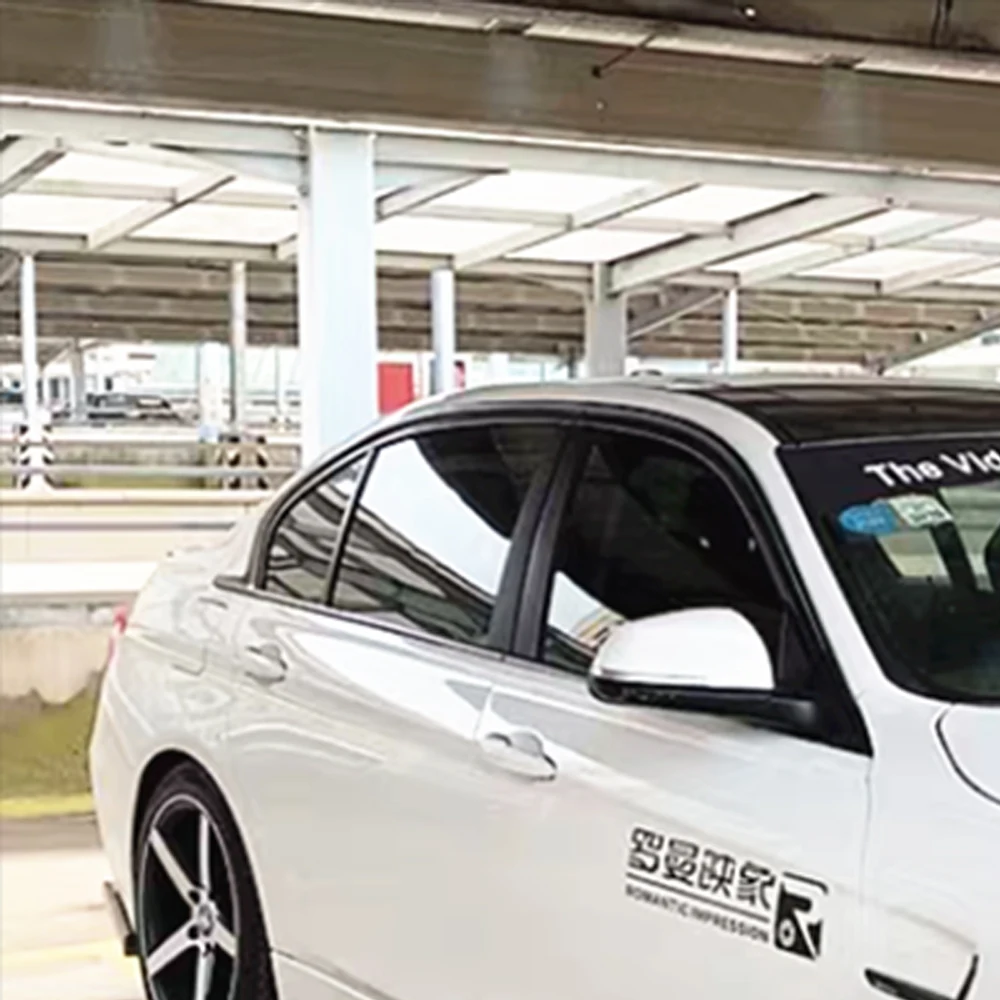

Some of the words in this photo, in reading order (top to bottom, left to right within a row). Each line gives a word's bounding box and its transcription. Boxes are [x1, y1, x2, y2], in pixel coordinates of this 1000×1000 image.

[863, 460, 944, 487] The
[625, 883, 690, 918] ROMANTIC
[690, 906, 770, 944] IMPRESSION
